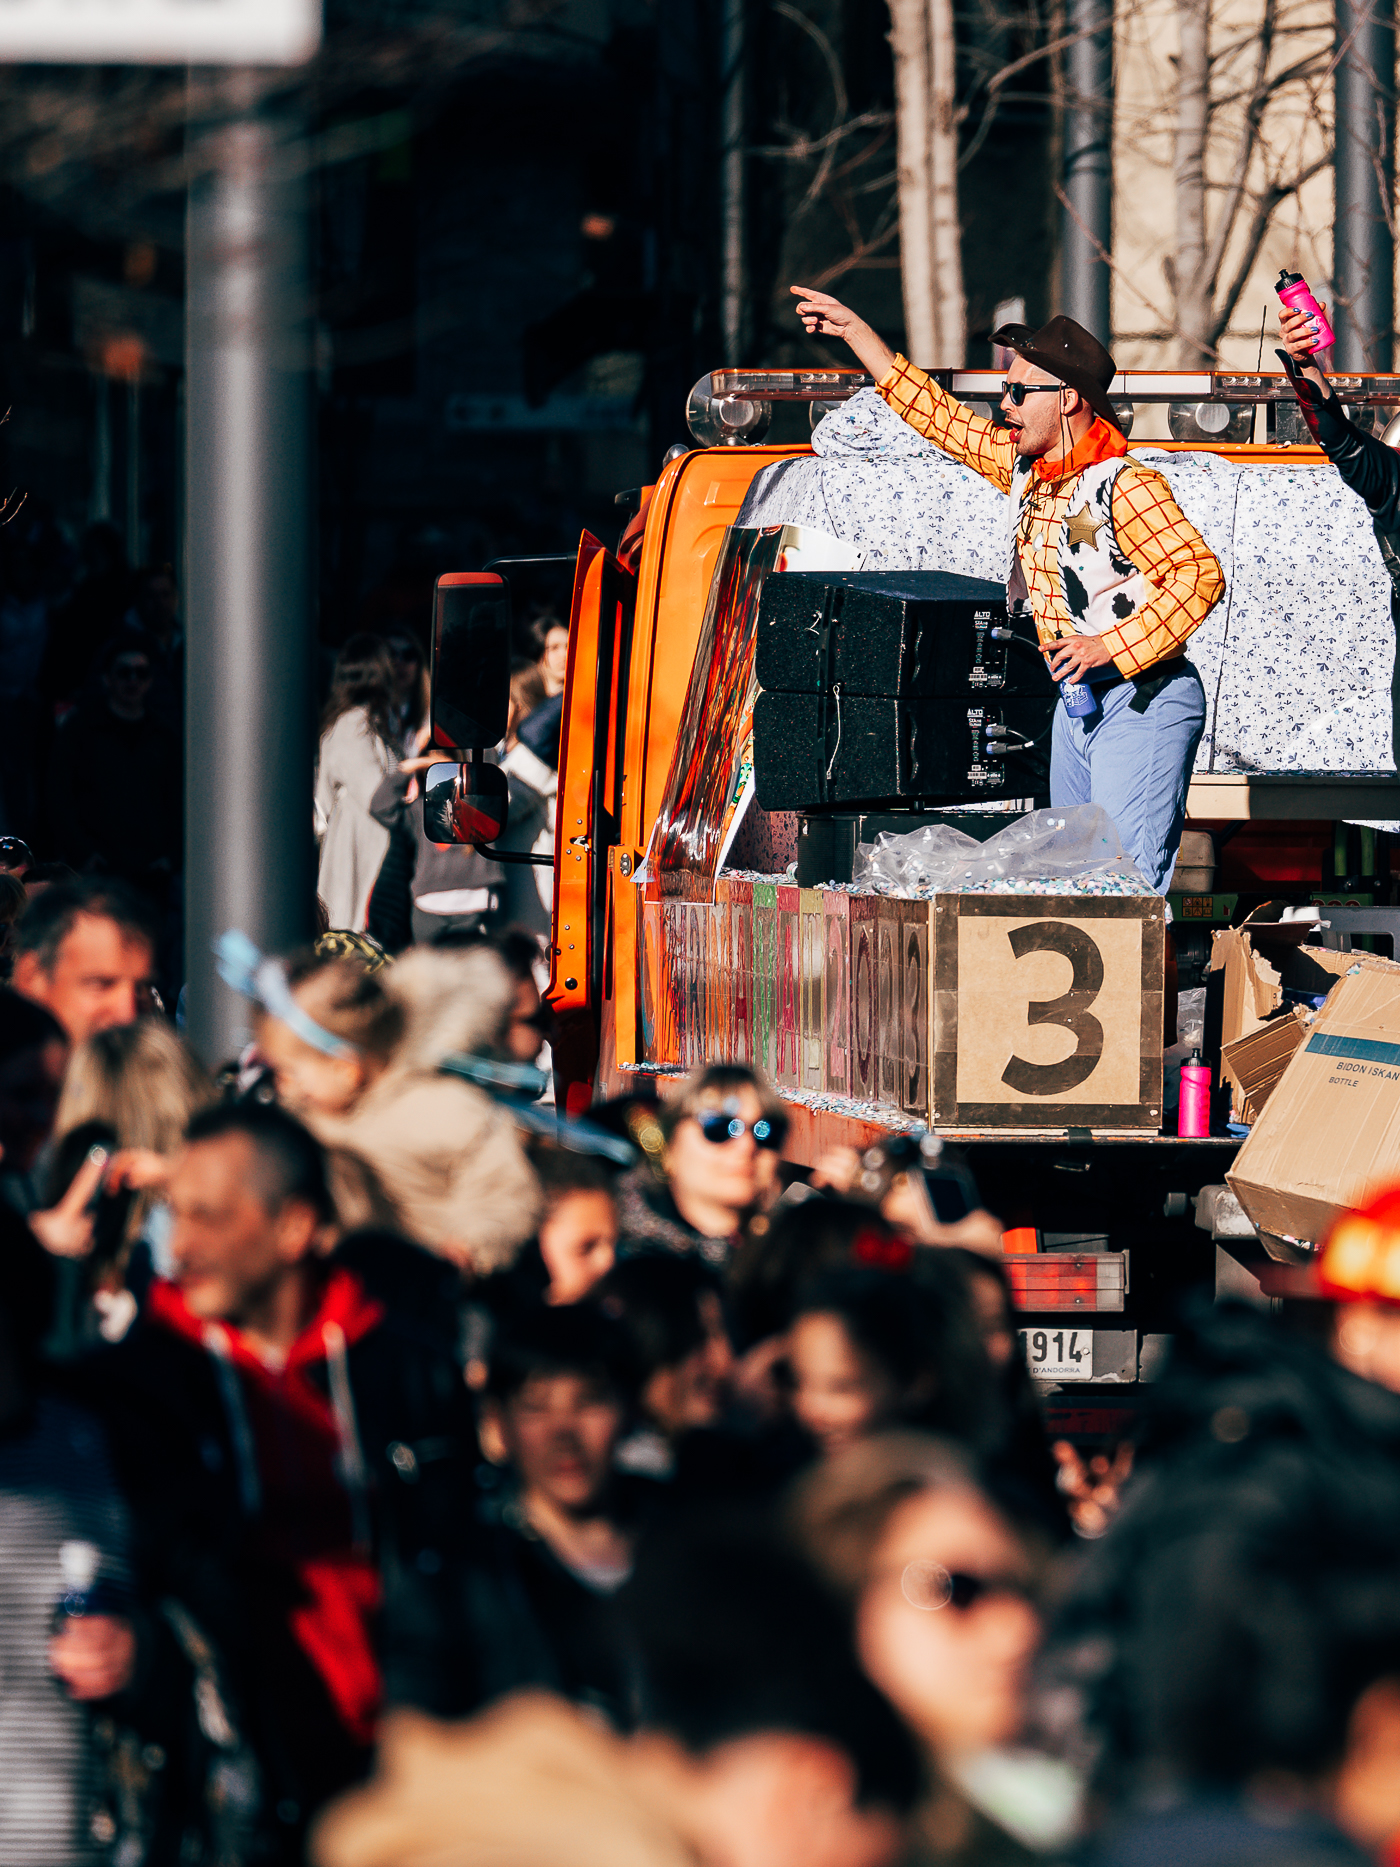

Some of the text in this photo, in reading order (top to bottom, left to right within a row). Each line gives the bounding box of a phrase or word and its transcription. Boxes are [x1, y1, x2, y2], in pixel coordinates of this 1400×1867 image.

[1001, 921, 1104, 1096] 3
[1336, 1061, 1400, 1081] BIDON ISKAN
[1329, 1076, 1359, 1087] BOTTLE
